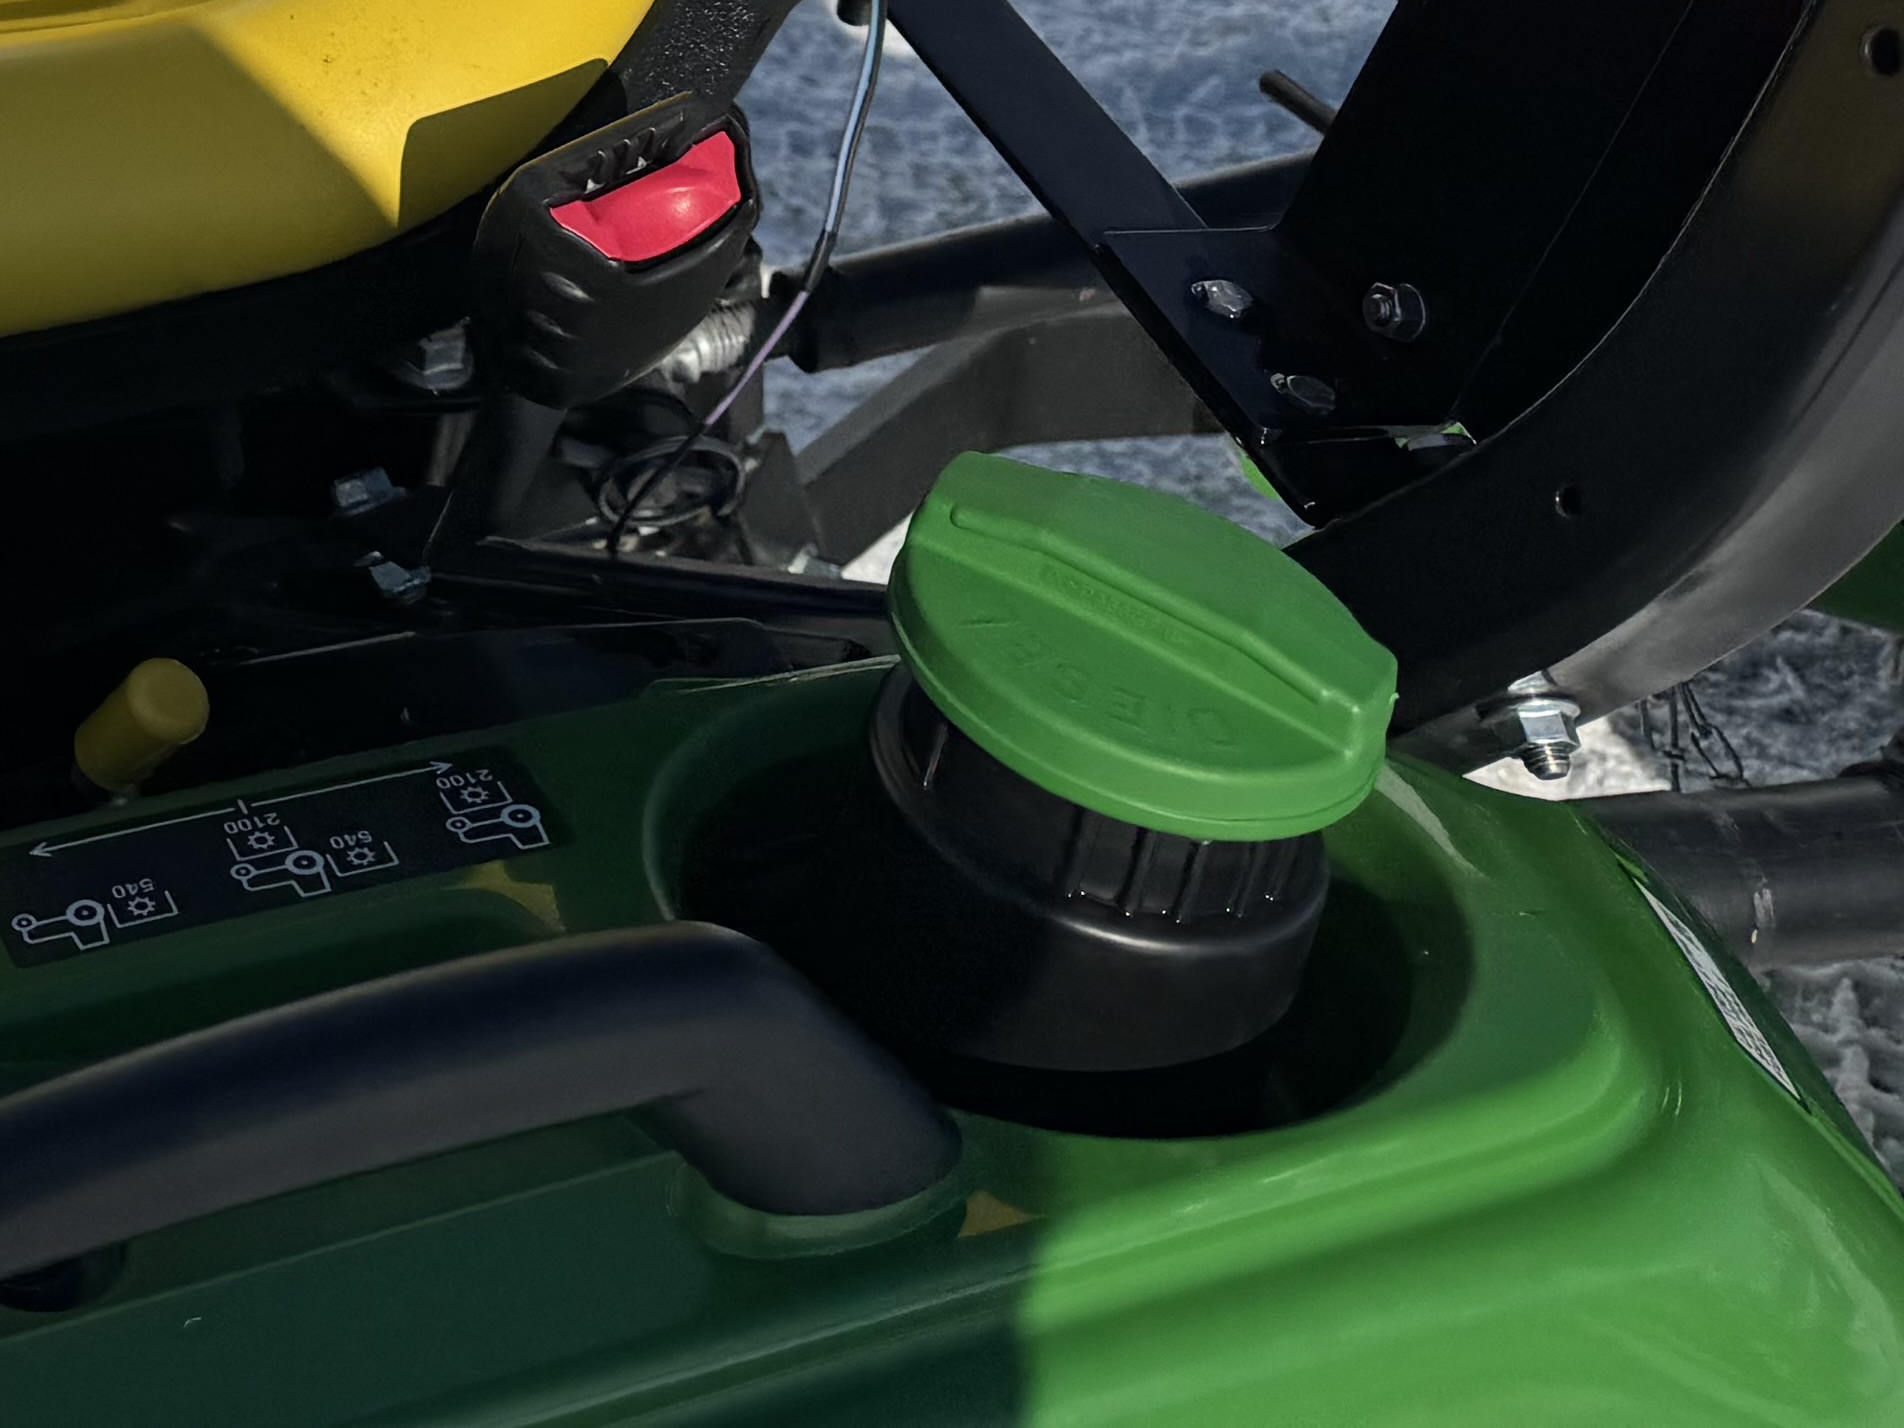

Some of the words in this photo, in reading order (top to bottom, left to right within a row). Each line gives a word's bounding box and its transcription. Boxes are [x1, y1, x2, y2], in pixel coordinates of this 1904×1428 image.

[434, 768, 494, 792] 2100
[222, 811, 282, 836] 2100
[329, 830, 374, 851] 540
[111, 876, 155, 900] 540
